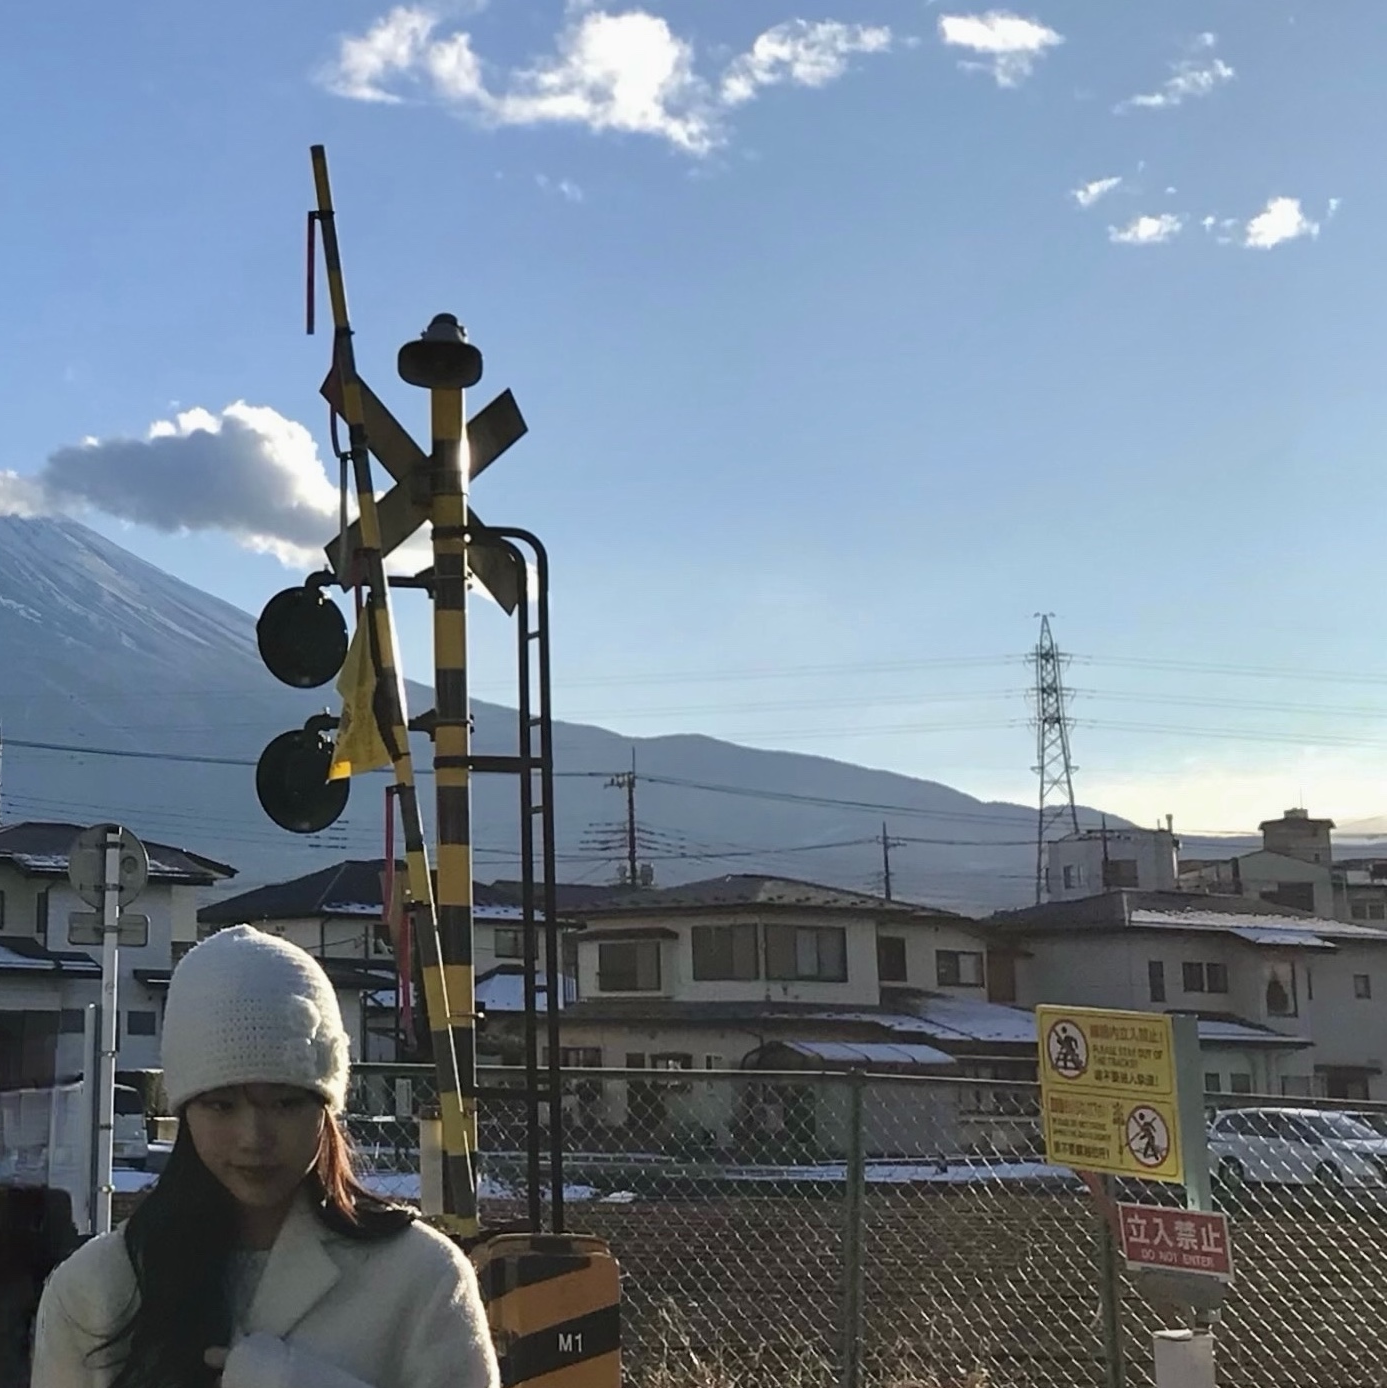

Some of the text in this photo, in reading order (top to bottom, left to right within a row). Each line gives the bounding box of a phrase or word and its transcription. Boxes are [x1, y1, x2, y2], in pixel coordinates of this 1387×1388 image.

[1127, 1213, 1223, 1254] 立入禁止
[1141, 1248, 1215, 1268] DO NOT ENTER
[558, 1333, 583, 1352] M1
